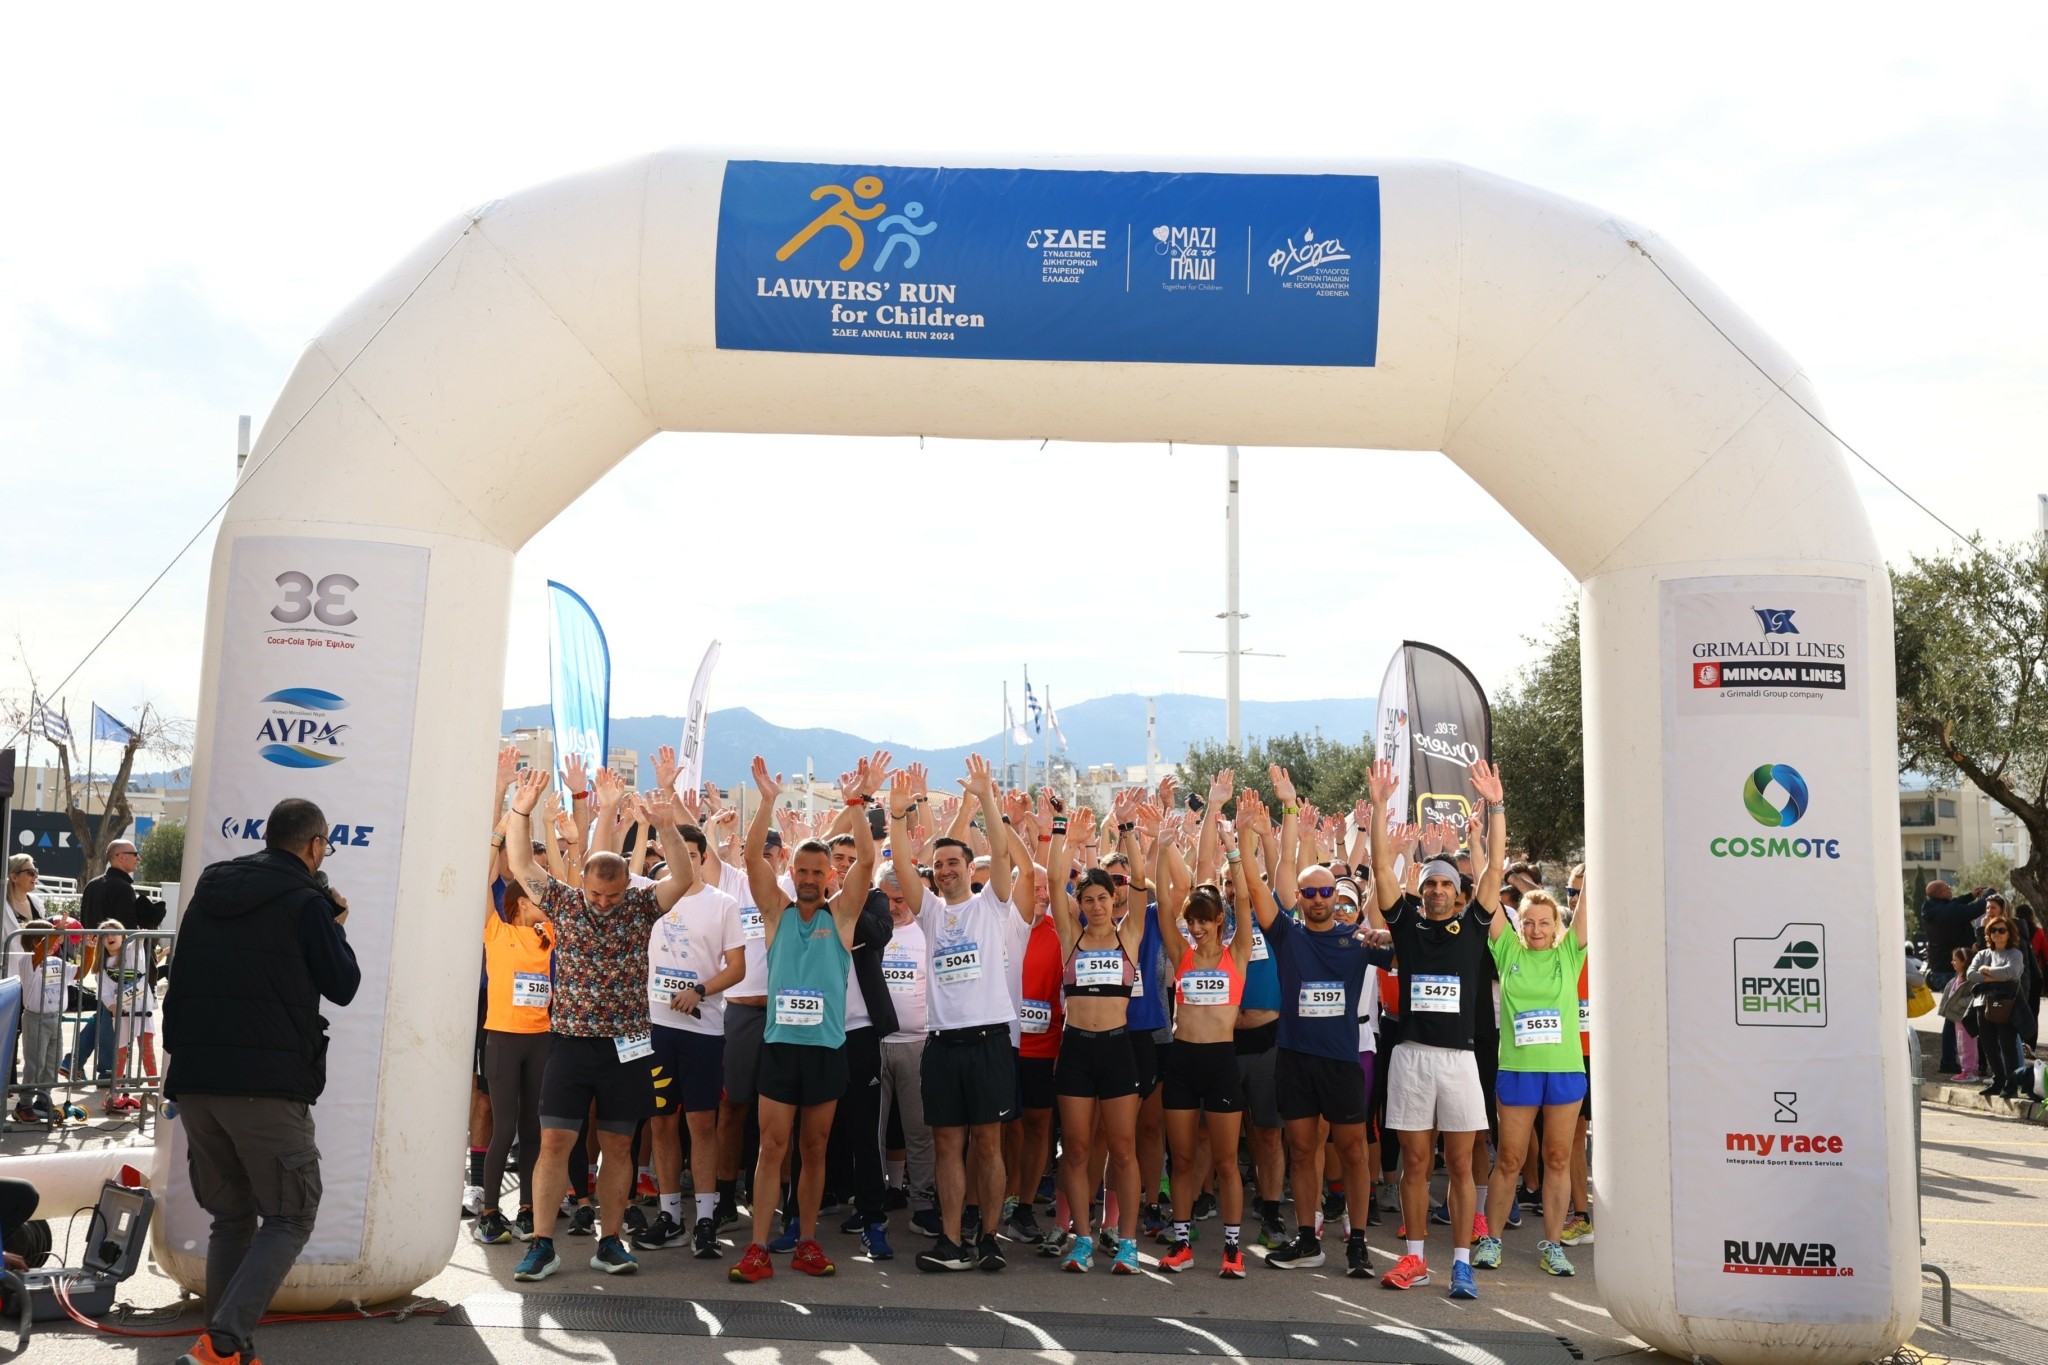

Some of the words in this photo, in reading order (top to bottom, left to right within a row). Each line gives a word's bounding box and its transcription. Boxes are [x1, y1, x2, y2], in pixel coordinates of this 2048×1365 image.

[1043, 229, 1106, 249] ΣΔΕΕ
[1171, 226, 1216, 248] ΜΑΖΙ
[1043, 250, 1091, 258] ΣΥΝΔΕΣΜΟΣ
[1042, 258, 1098, 266] ΔΙΚΗΓΟΡΙΚΩΝ
[1042, 267, 1085, 275] ΕΤΑΙΡΕΙΩΝ
[1170, 257, 1216, 280] ΠΑΙΔΙ
[1042, 275, 1080, 283] ΕΛΛΑΔΟΣ
[756, 277, 890, 301] LAWYERS'
[899, 283, 957, 304] RUN
[1161, 282, 1188, 292] Together
[1198, 283, 1224, 291] Children
[1293, 282, 1350, 290] ΝΕΟΠΛΑΣΜΑΤΙΚΗ
[831, 303, 868, 323] for
[876, 305, 985, 327] Children
[832, 328, 859, 338] ΣΔΕΕ
[861, 329, 903, 339] ANNUAL
[905, 331, 927, 340] RUN
[930, 332, 955, 341] 2024
[267, 636, 304, 646] Coca-Cola
[306, 638, 323, 648] Τρία
[1692, 641, 1789, 658] GRIMALDI
[1796, 642, 1845, 659] LINES
[1722, 667, 1797, 681] MINOAN
[1801, 668, 1842, 683] LINES
[1727, 690, 1761, 698] Grimaldi
[1762, 690, 1788, 700] Group
[1789, 692, 1824, 701] company
[1710, 837, 1841, 860] COSMOTE
[946, 953, 976, 968] 5041
[1090, 960, 1119, 970] 5146
[884, 970, 914, 980] 5034
[529, 982, 549, 994] 5186
[663, 978, 695, 991] 5509
[1196, 980, 1225, 990] 5129
[1742, 977, 1820, 996] ΑΡΧΕΙΟ
[1313, 992, 1341, 1002] 5197
[1425, 985, 1457, 997] 5475
[790, 998, 819, 1010] 5521
[1743, 996, 1821, 1014] ΘΗΚΗ
[1021, 1009, 1048, 1021] 5001
[1527, 1019, 1557, 1030] 5633
[1726, 1133, 1776, 1157] my
[1780, 1134, 1843, 1153] race
[1726, 1158, 1765, 1166] Integrated
[1767, 1159, 1787, 1167] Sport
[1724, 1239, 1837, 1267] RUNNER
[1729, 1266, 1831, 1275] MAGAZINE
